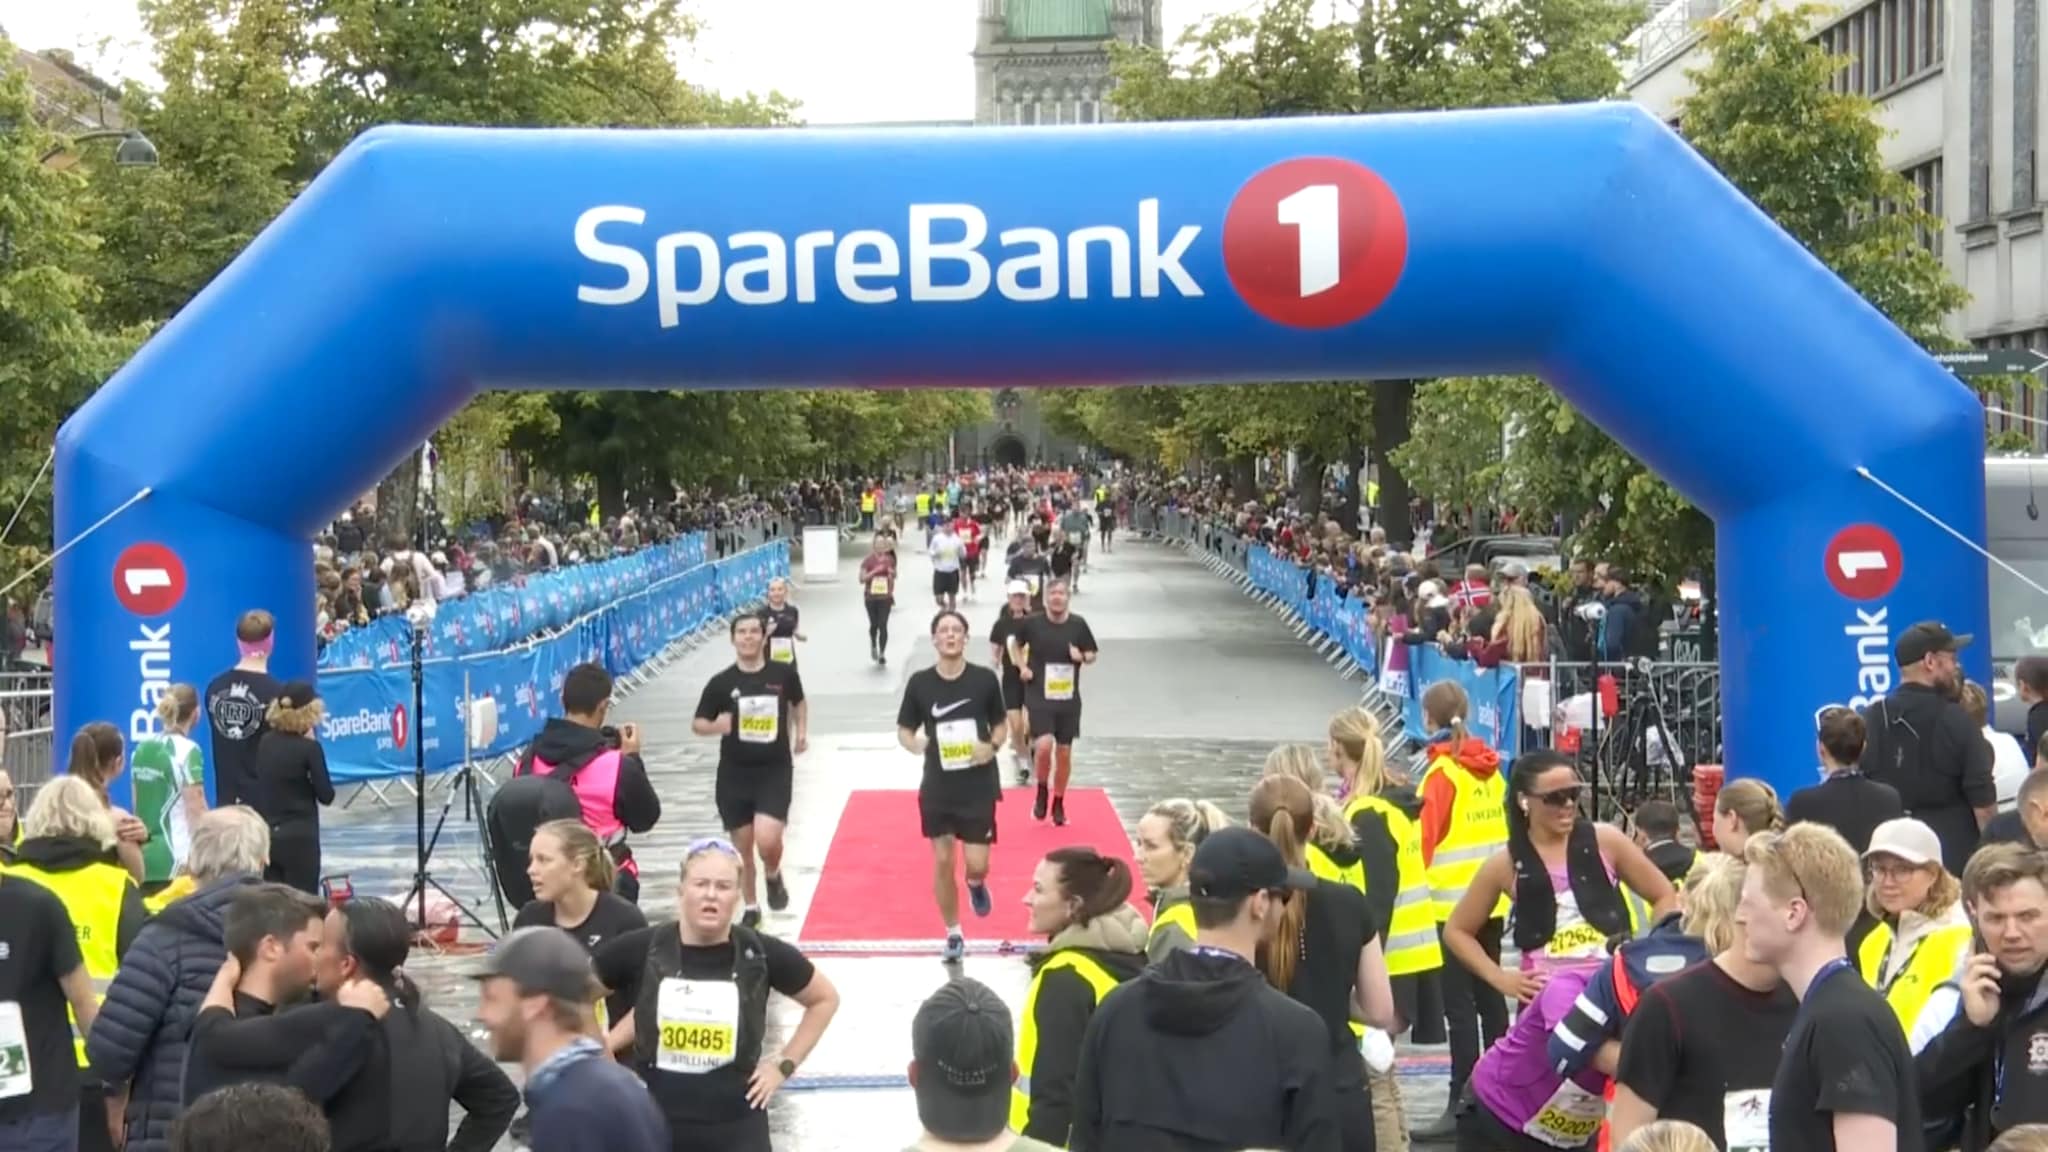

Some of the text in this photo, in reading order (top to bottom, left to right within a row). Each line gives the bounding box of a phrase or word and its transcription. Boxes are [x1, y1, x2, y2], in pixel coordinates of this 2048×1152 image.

[573, 198, 1204, 328] SpareBank
[321, 706, 392, 742] SpareBank
[1551, 927, 1598, 953] 27262
[663, 1026, 724, 1050] 30485
